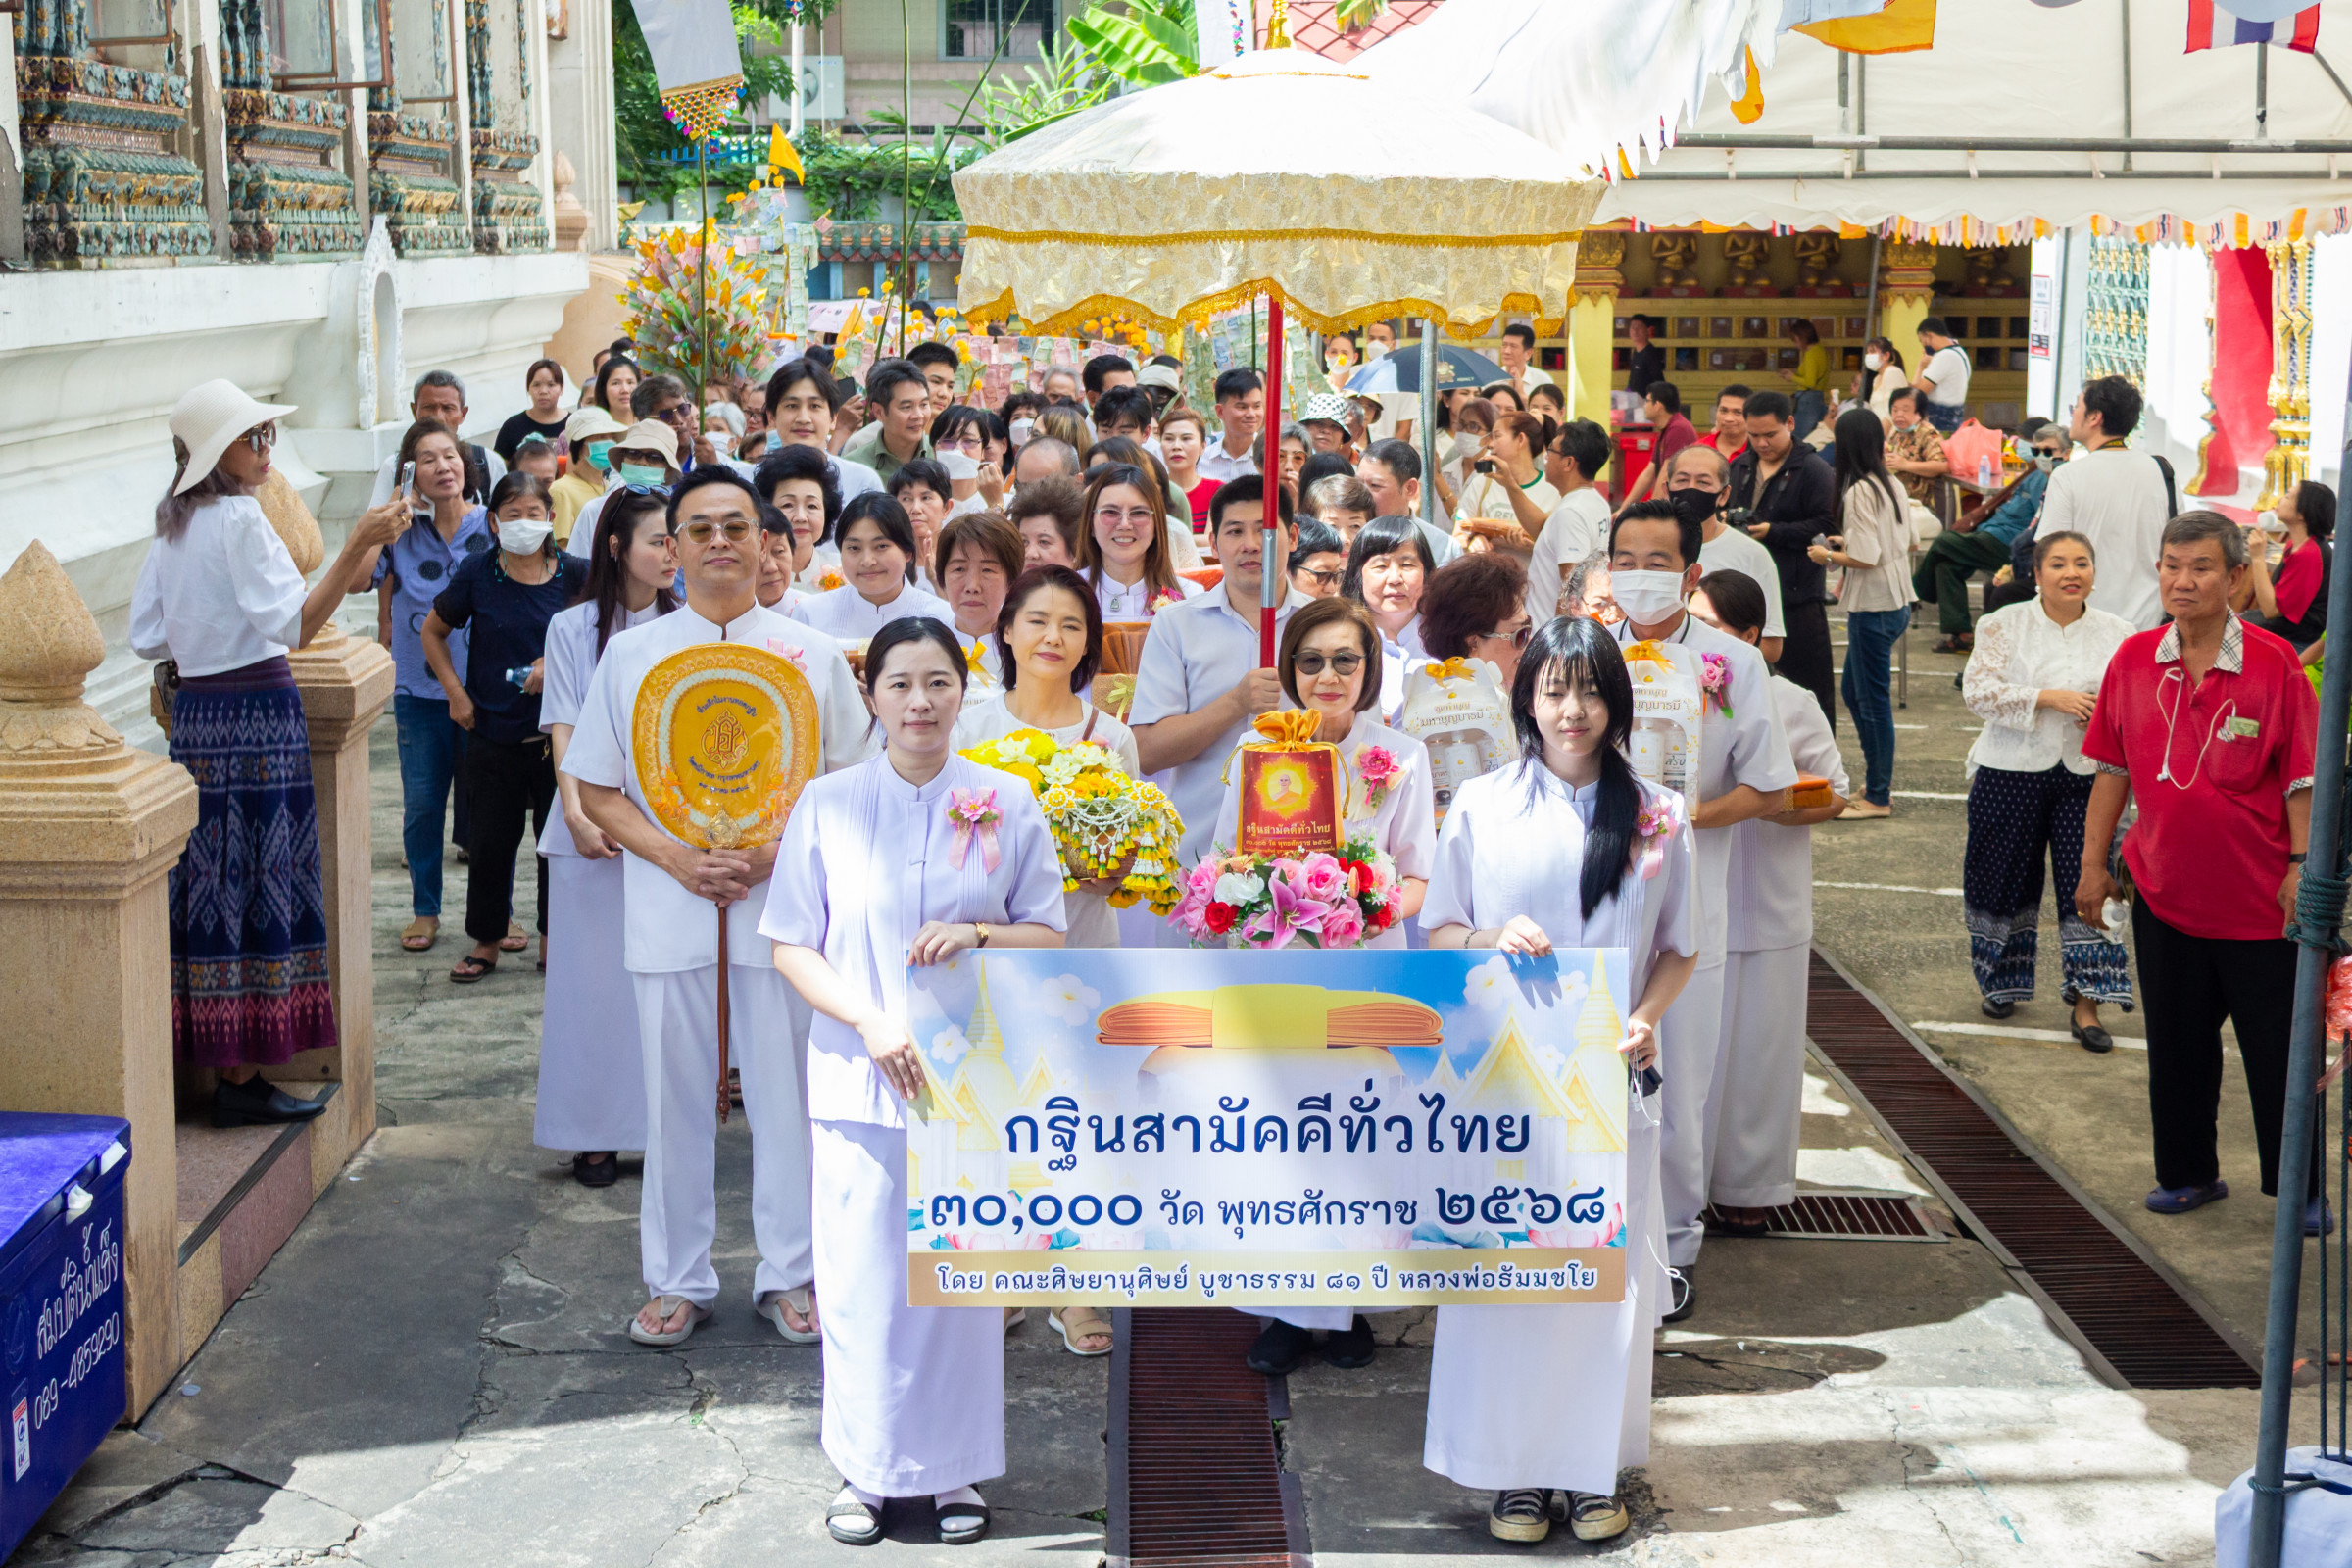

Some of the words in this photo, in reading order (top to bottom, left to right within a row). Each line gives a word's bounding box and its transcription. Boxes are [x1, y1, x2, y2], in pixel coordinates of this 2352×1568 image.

[1246, 820, 1331, 837] กฐินสามัคคีทั่วไทย
[1004, 1078, 1531, 1171] กฐินสามัคคีทั่วไทย
[931, 1193, 1144, 1234] ๓๐,๐๐๐
[1159, 1189, 1204, 1226] วัด
[1218, 1189, 1419, 1239] พุทธศักราช
[1435, 1185, 1606, 1225] ๒๕๖๘
[938, 1266, 983, 1290] โดย
[996, 1264, 1187, 1297] คณะศิษยานุศิษย์
[1200, 1273, 1315, 1297] บูชาธรรม
[1327, 1273, 1360, 1290] ๘๑
[1372, 1265, 1388, 1288] ปี
[1399, 1263, 1595, 1289] หลวงพ่อธัมมชโย
